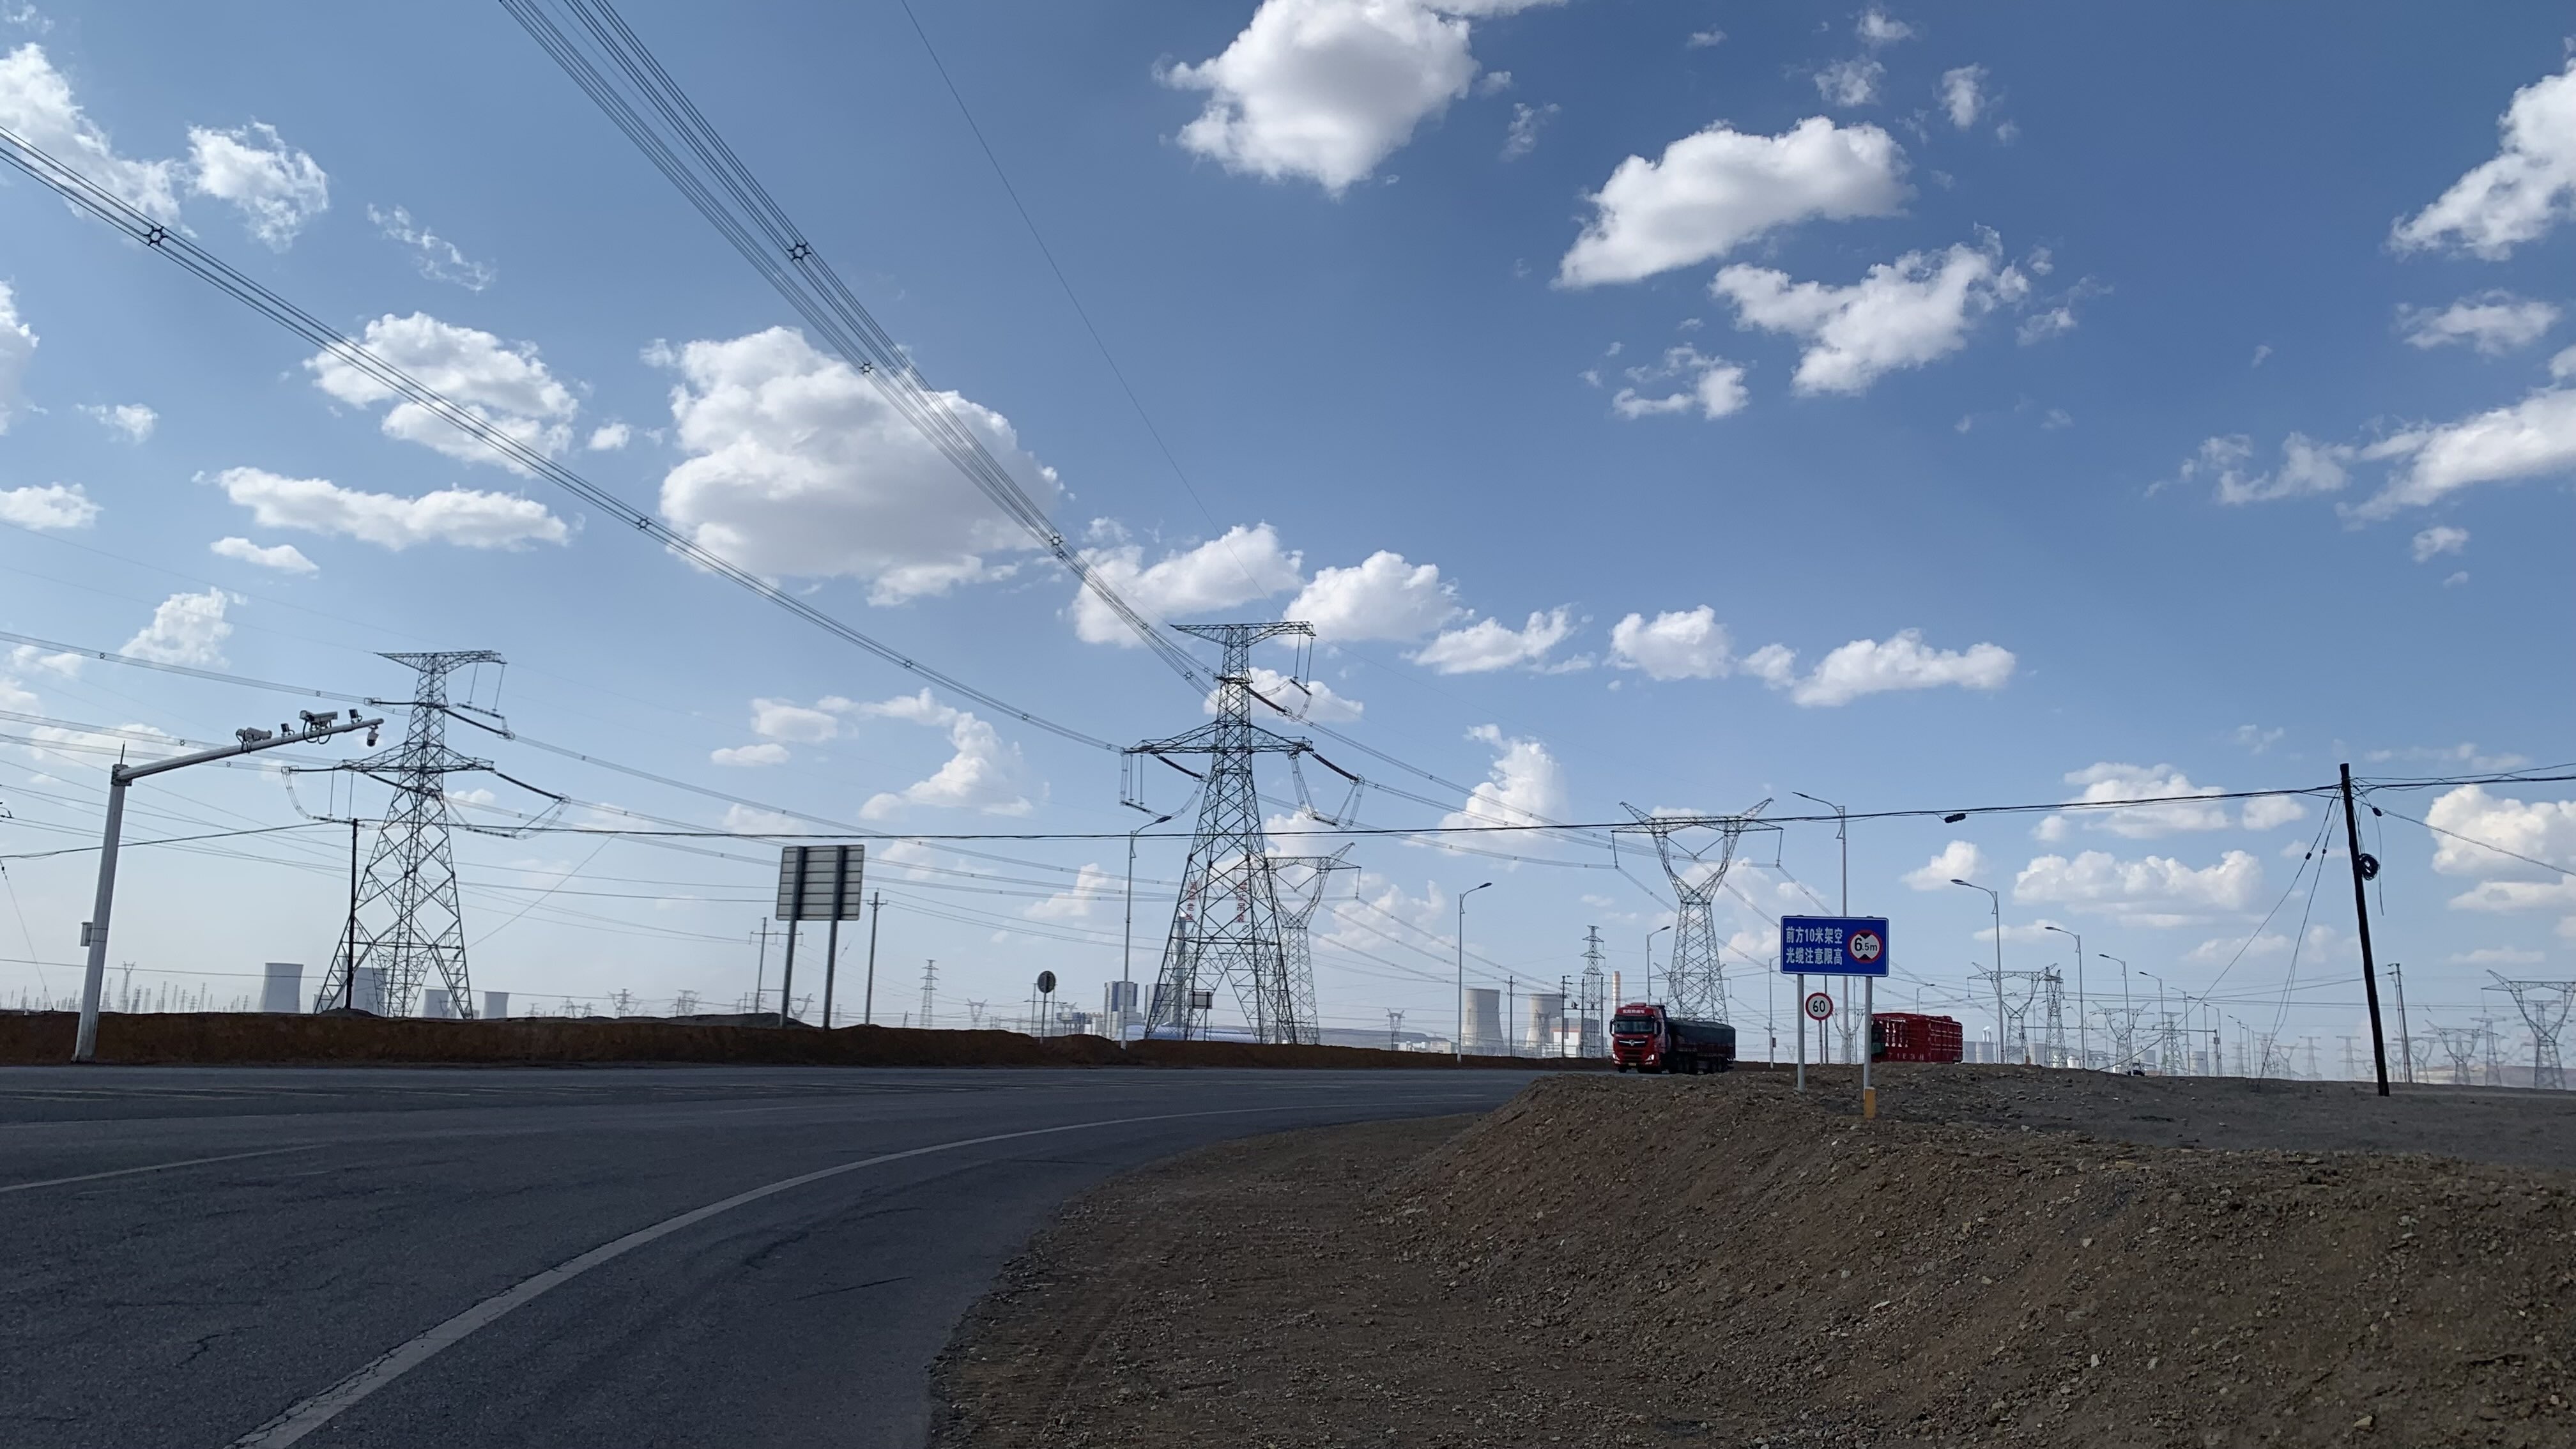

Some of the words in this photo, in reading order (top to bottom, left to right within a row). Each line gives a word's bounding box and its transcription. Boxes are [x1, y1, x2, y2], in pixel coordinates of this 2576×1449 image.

[1786, 926, 1843, 944] 前方10米架空
[1854, 937, 1878, 951] 6.5m
[1786, 947, 1843, 965] 光缆注意限高
[1813, 1000, 1825, 1013] 60
